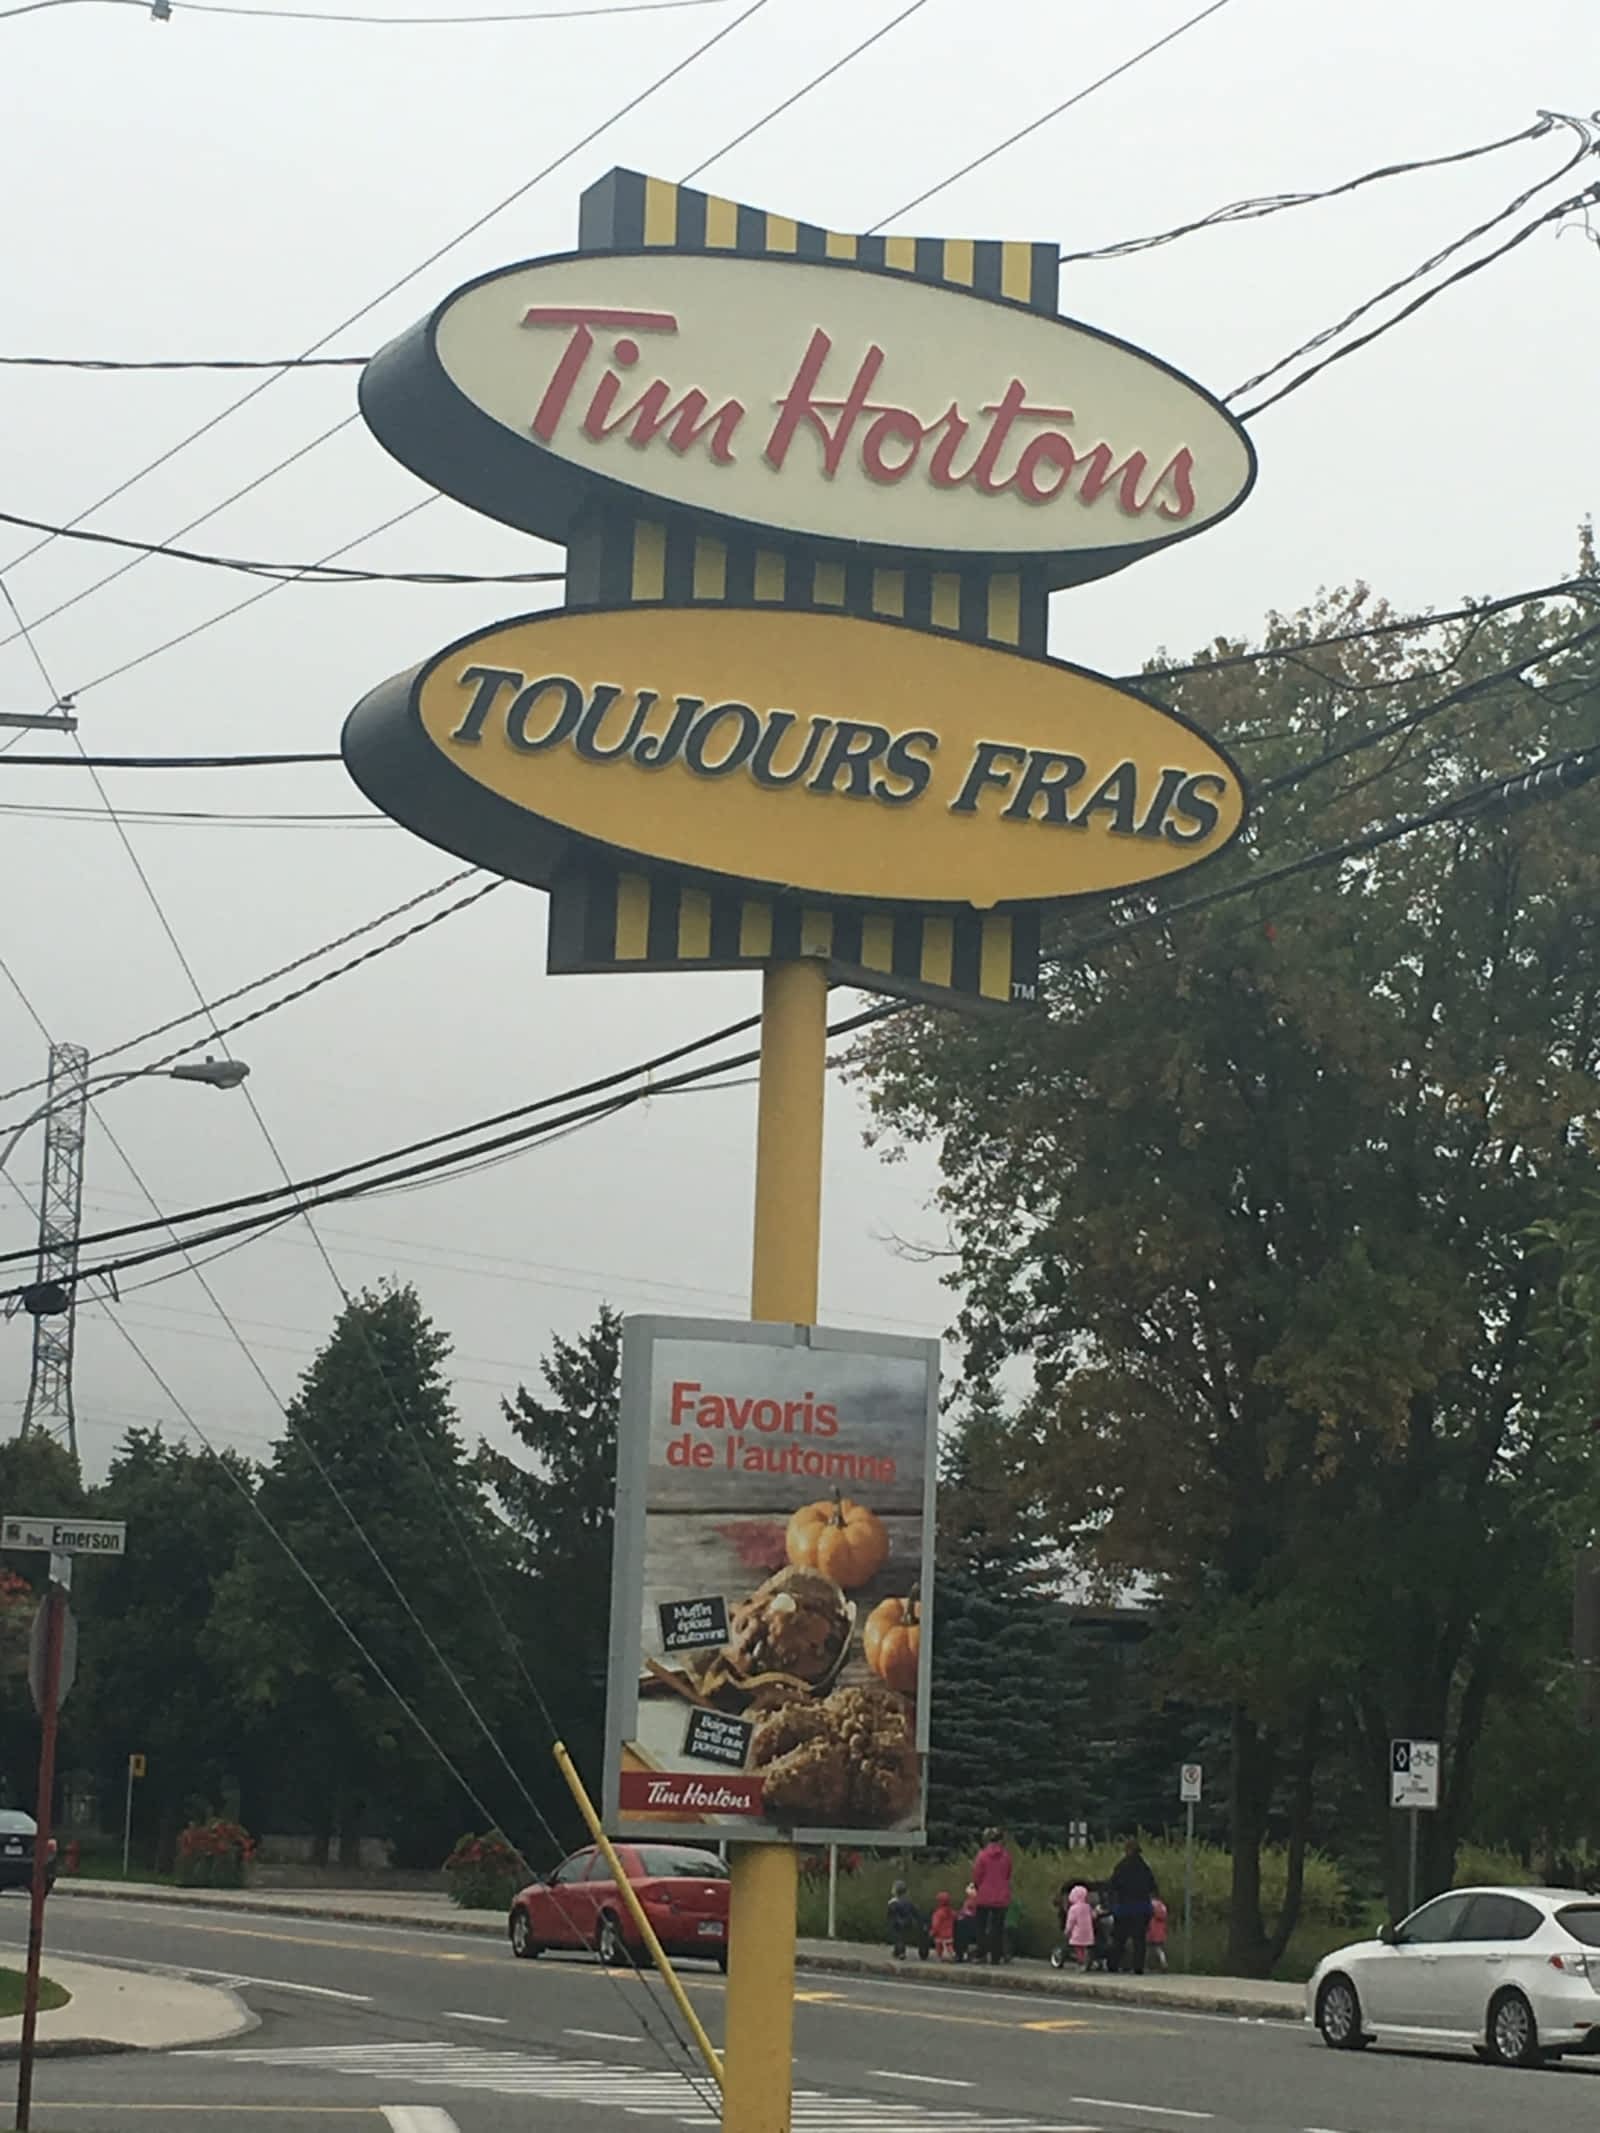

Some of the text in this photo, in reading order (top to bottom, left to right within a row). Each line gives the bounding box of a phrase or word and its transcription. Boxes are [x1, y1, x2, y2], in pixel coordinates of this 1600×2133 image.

[521, 308, 1198, 522] Tim Hortons
[450, 665, 1229, 847] TOUJOURS FRAIS
[1012, 982, 1035, 1000] TM
[670, 1381, 839, 1437] Favoris
[666, 1433, 896, 1483] de l'automne
[52, 1525, 120, 1549] Emerson
[647, 1781, 751, 1808] Tim Hortons
